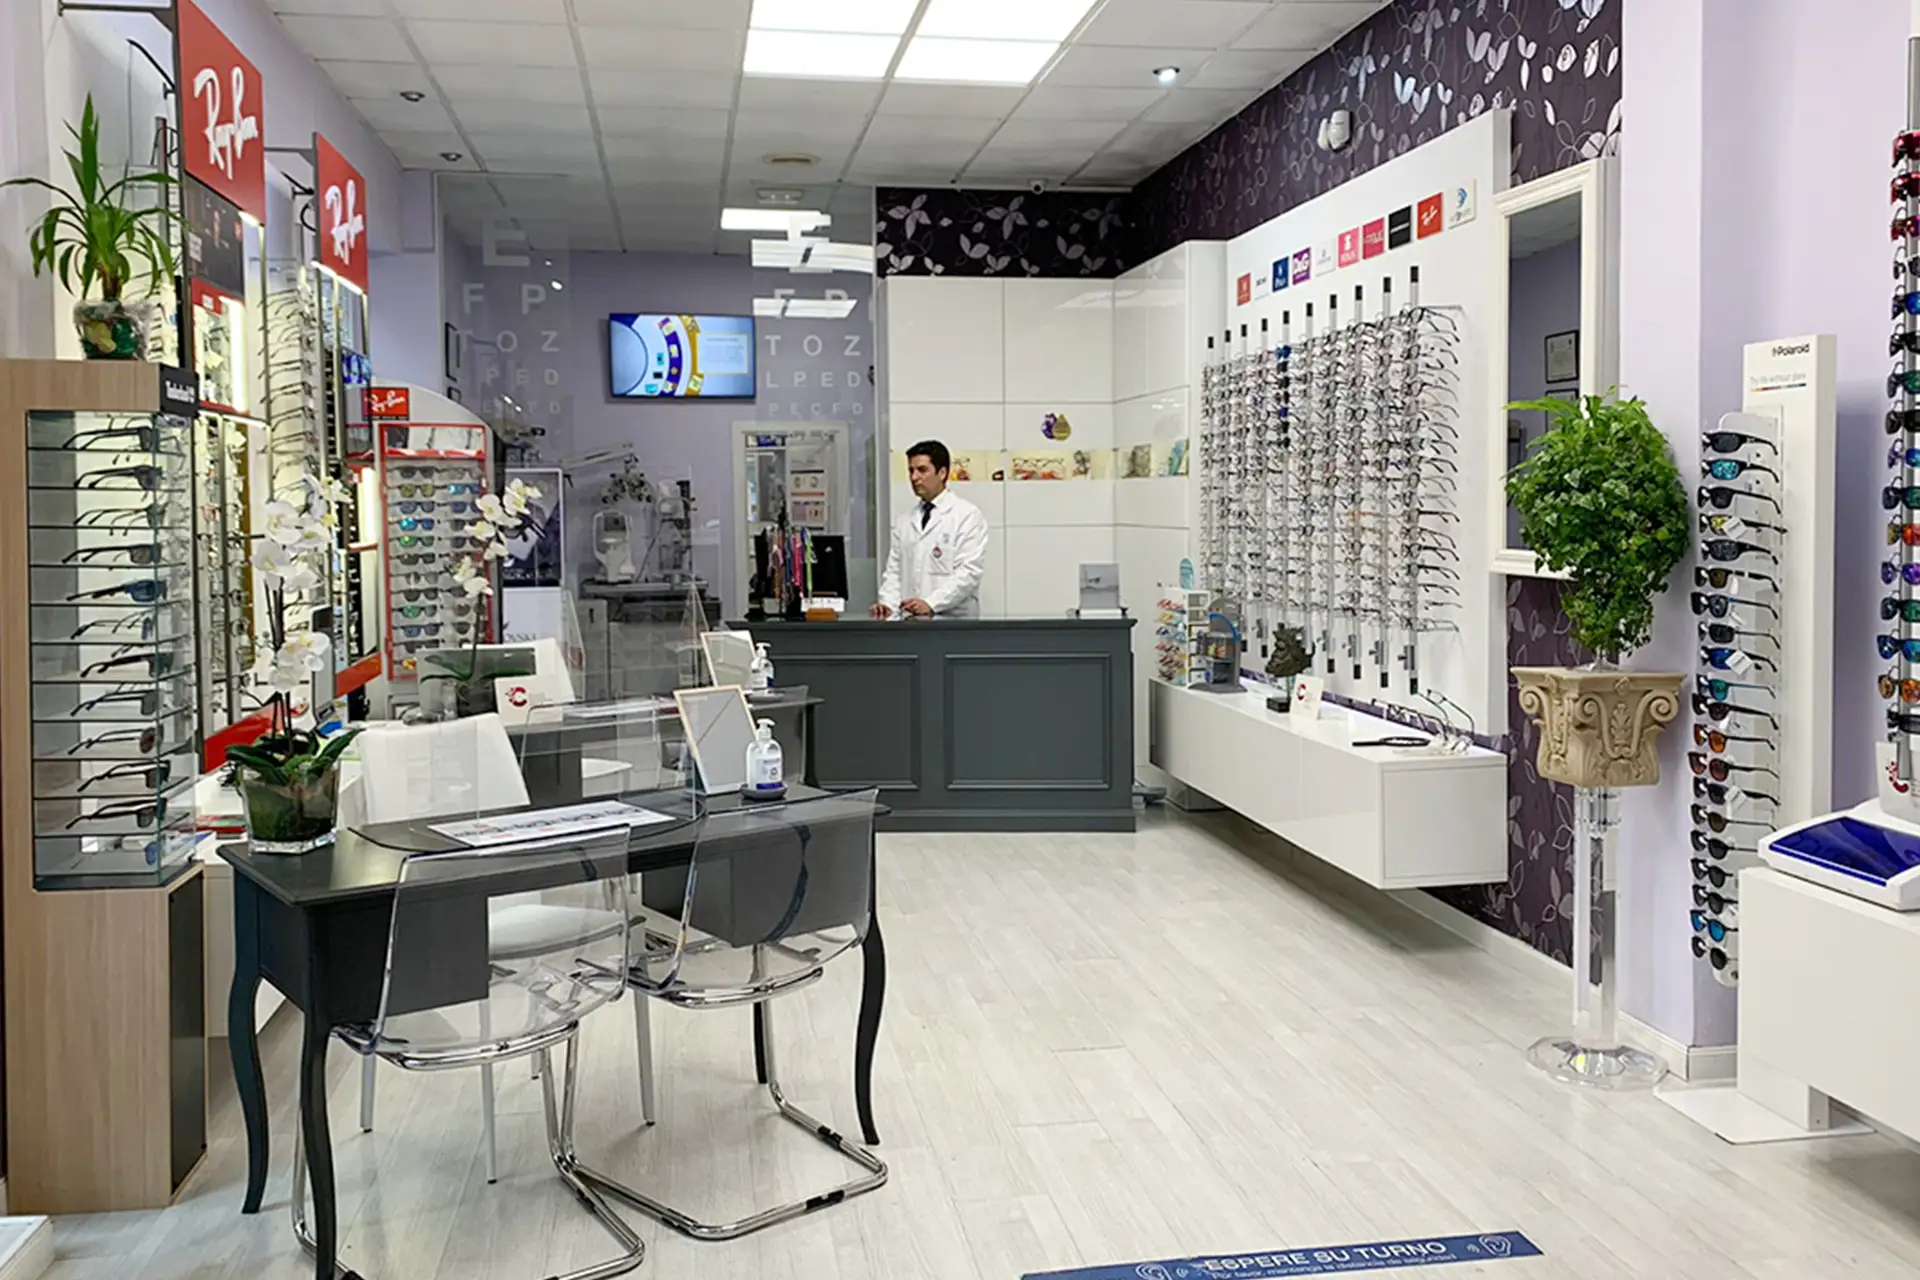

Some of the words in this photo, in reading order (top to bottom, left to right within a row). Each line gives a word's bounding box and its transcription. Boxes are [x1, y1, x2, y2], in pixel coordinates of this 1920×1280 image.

[1204, 1252, 1310, 1271] ESPERE
[1313, 1250, 1350, 1263] SU
[1352, 1241, 1447, 1259] TURNO
